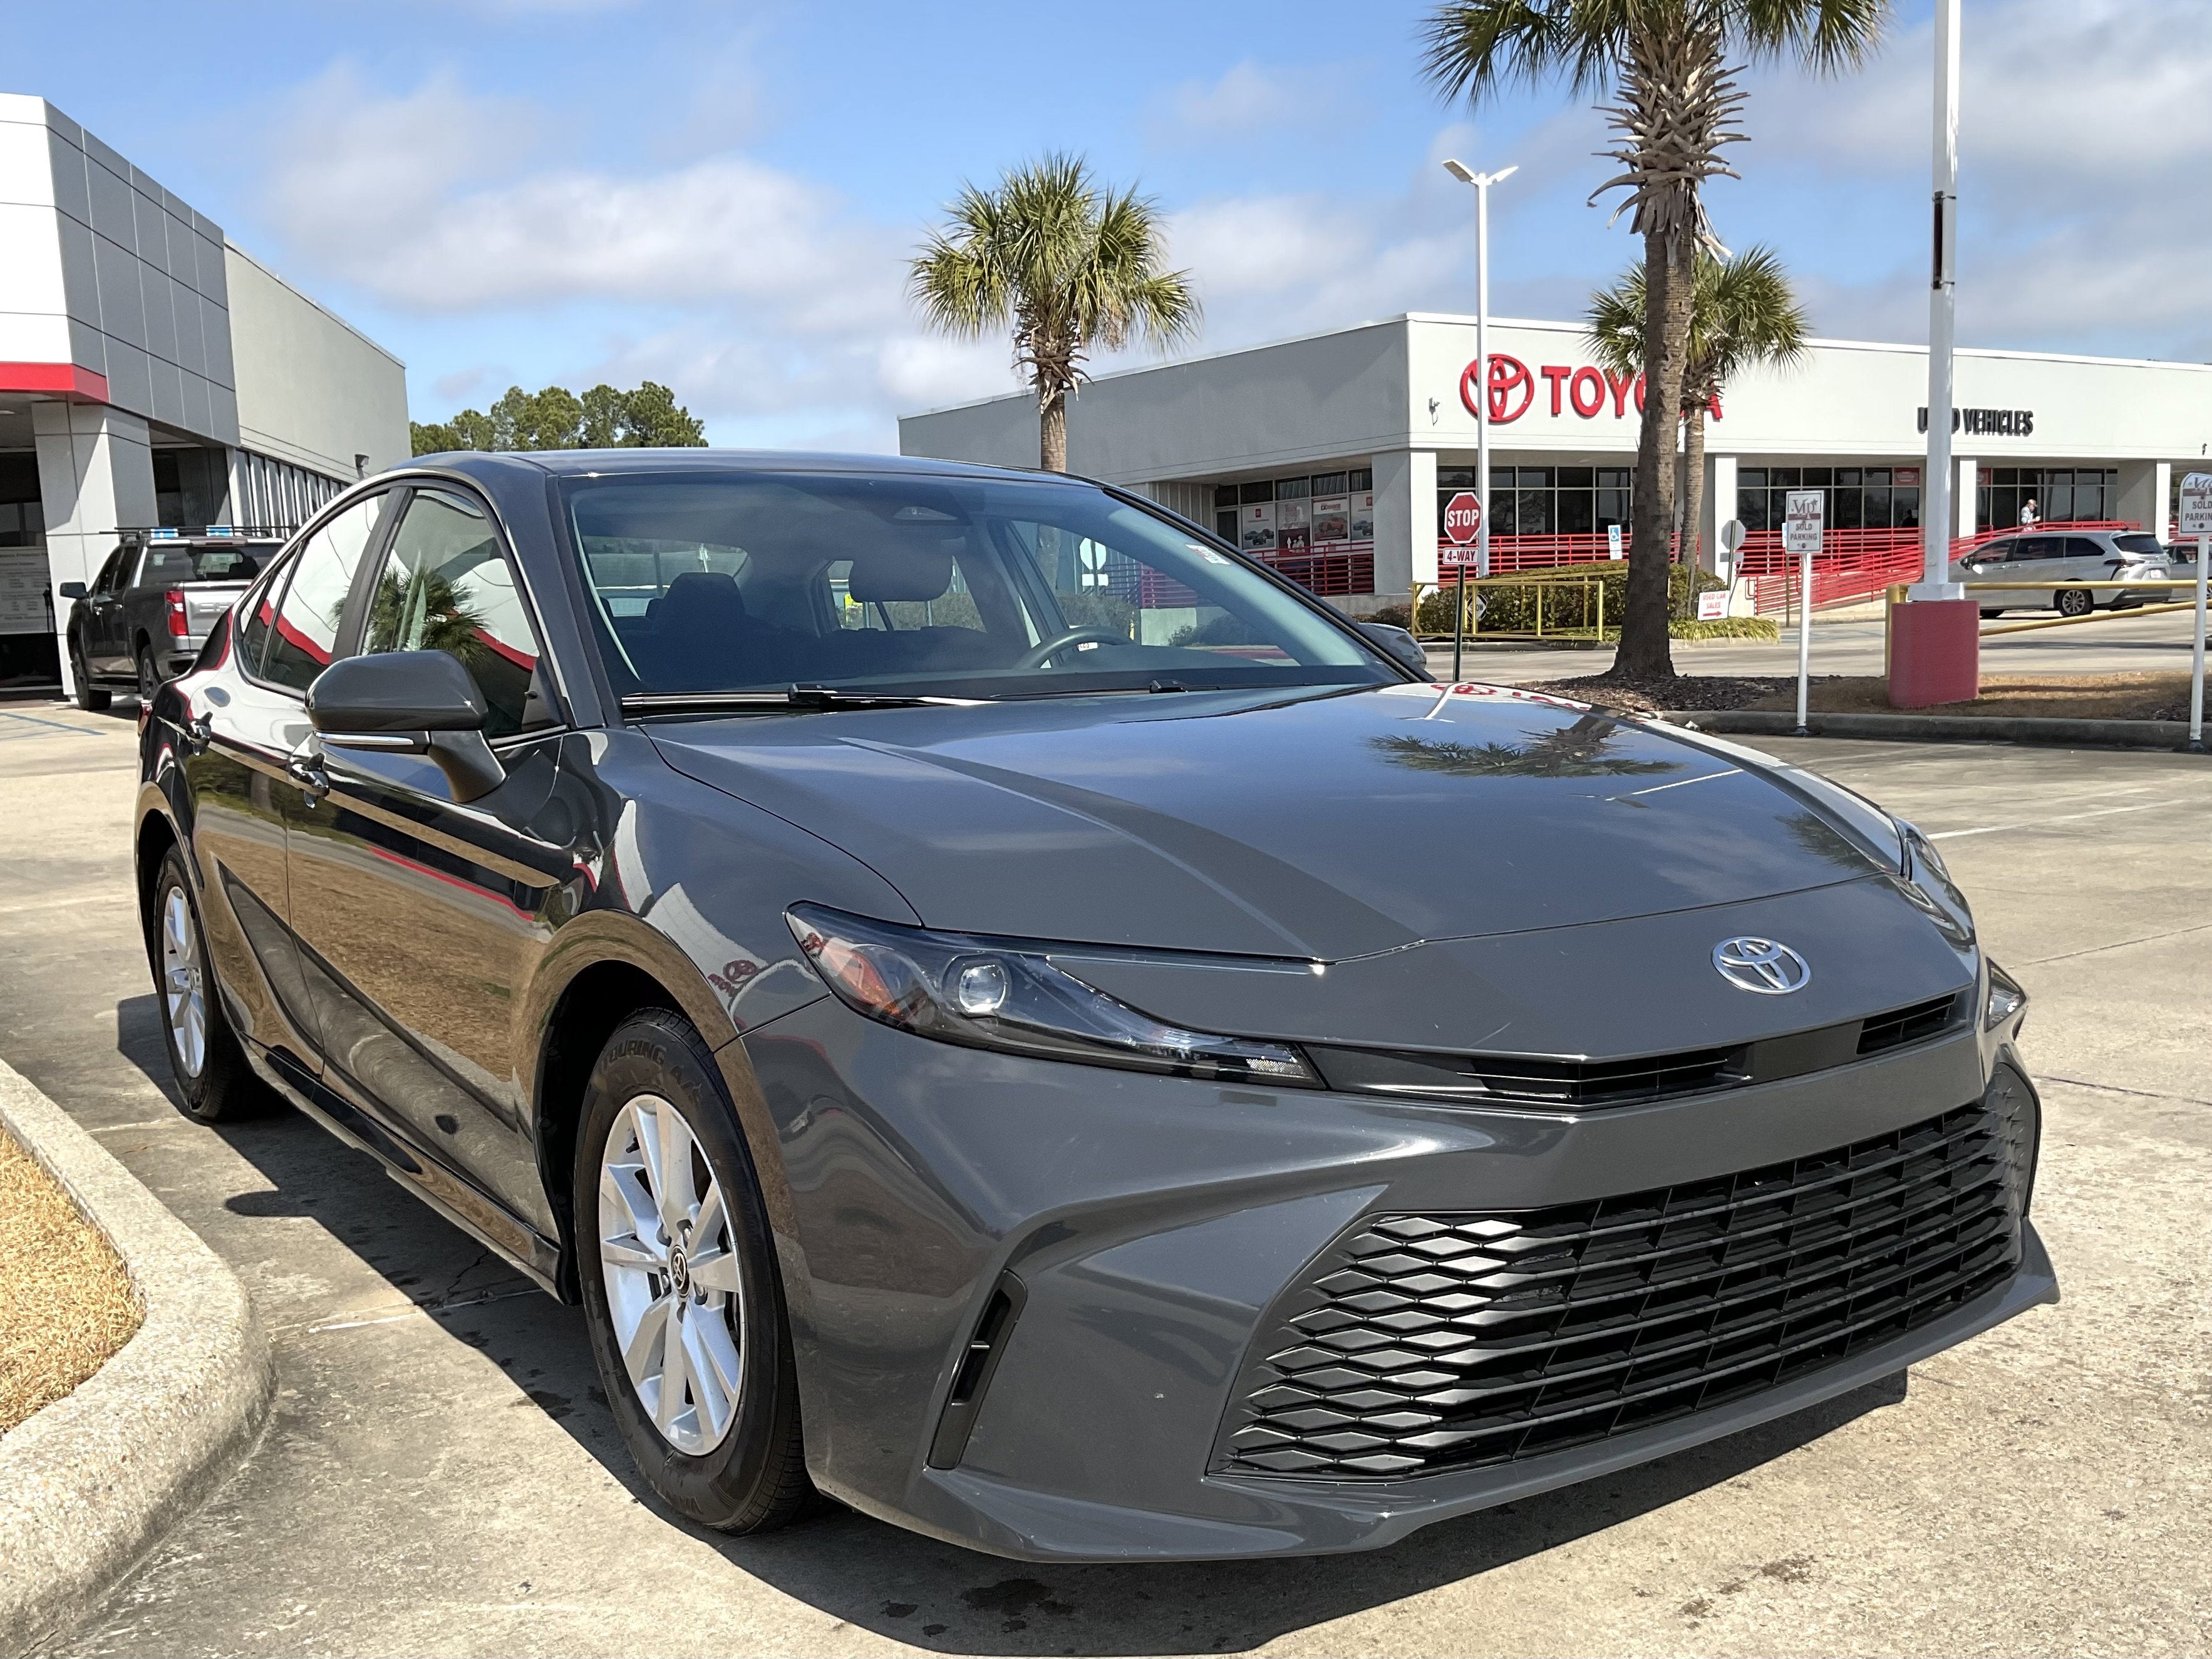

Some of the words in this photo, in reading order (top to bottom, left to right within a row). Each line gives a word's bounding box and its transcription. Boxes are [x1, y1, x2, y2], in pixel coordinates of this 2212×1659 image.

[1541, 365, 1724, 419] TOY
[1917, 407, 1960, 434] UD
[1963, 408, 2034, 437] VEHICLES
[1447, 509, 1479, 527] STOP
[1447, 550, 1476, 562] 4-WAY
[1470, 604, 1484, 612] SOW
